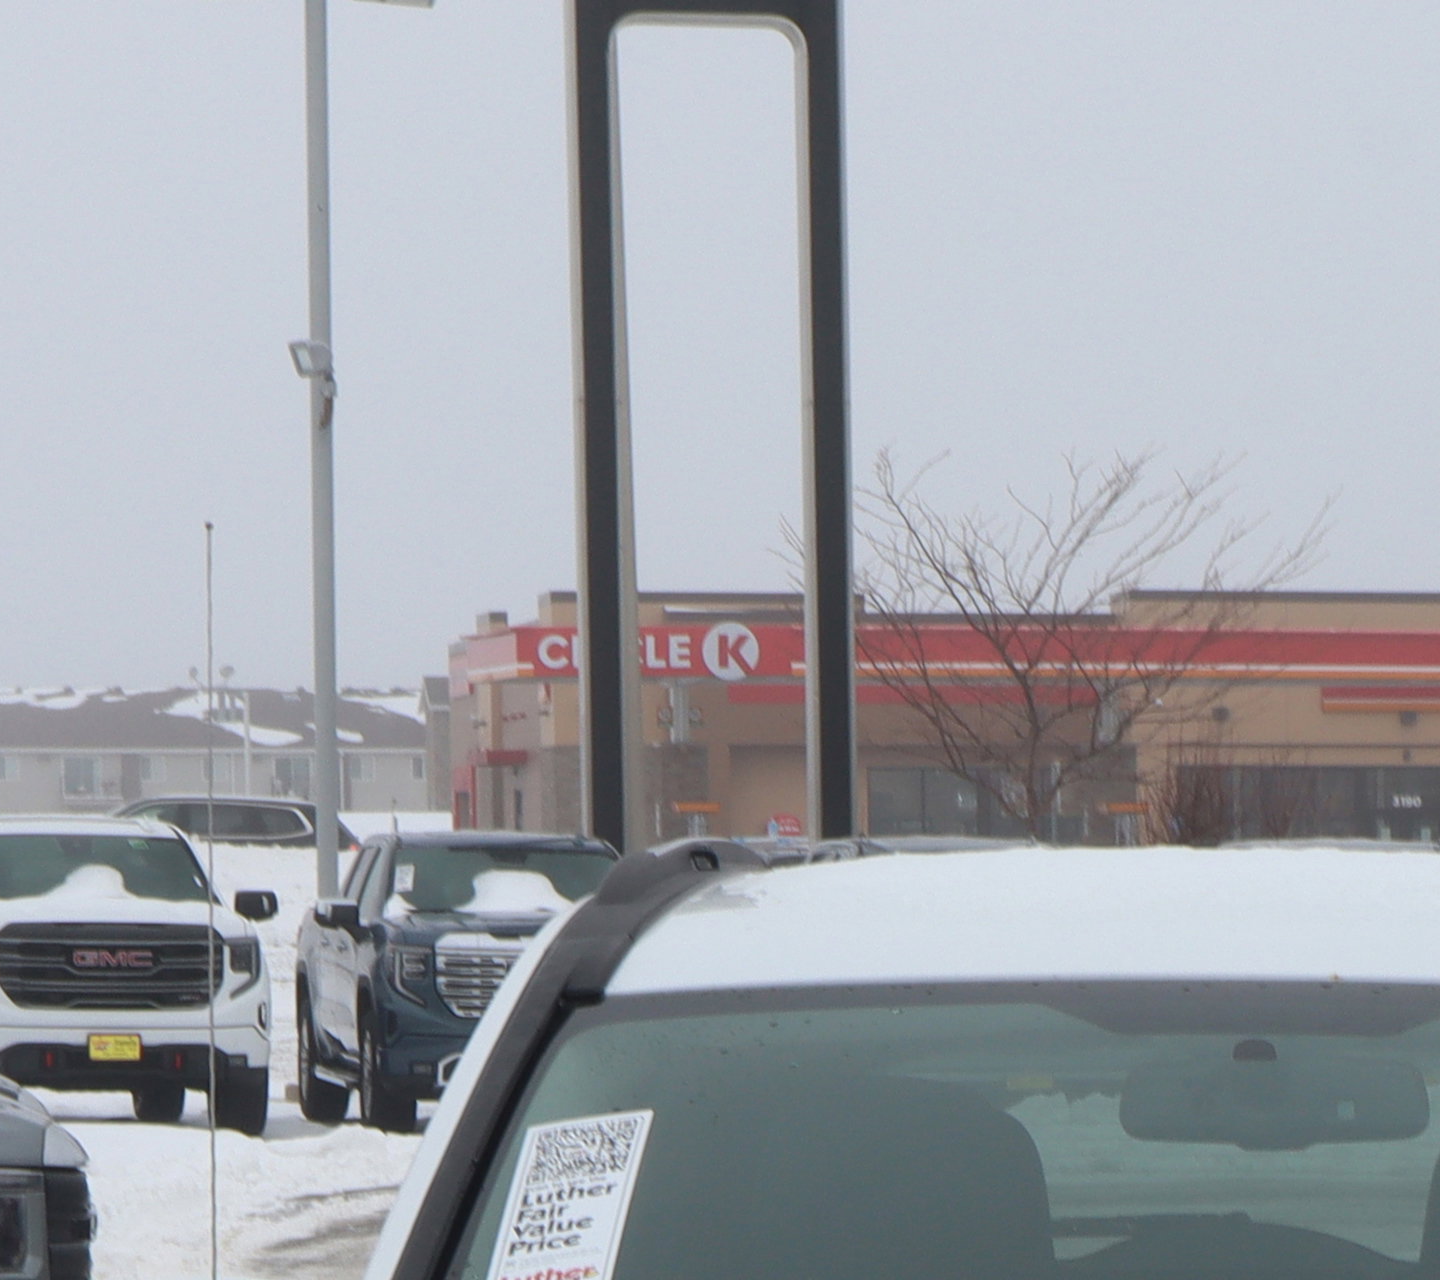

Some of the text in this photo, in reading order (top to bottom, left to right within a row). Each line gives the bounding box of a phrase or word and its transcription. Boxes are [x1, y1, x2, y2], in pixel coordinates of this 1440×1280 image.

[538, 631, 756, 679] CILE K
[73, 950, 153, 967] GMC
[521, 1182, 617, 1207] Luther
[517, 1203, 570, 1224] Fair
[513, 1217, 594, 1240] Value
[508, 1234, 582, 1257] Price
